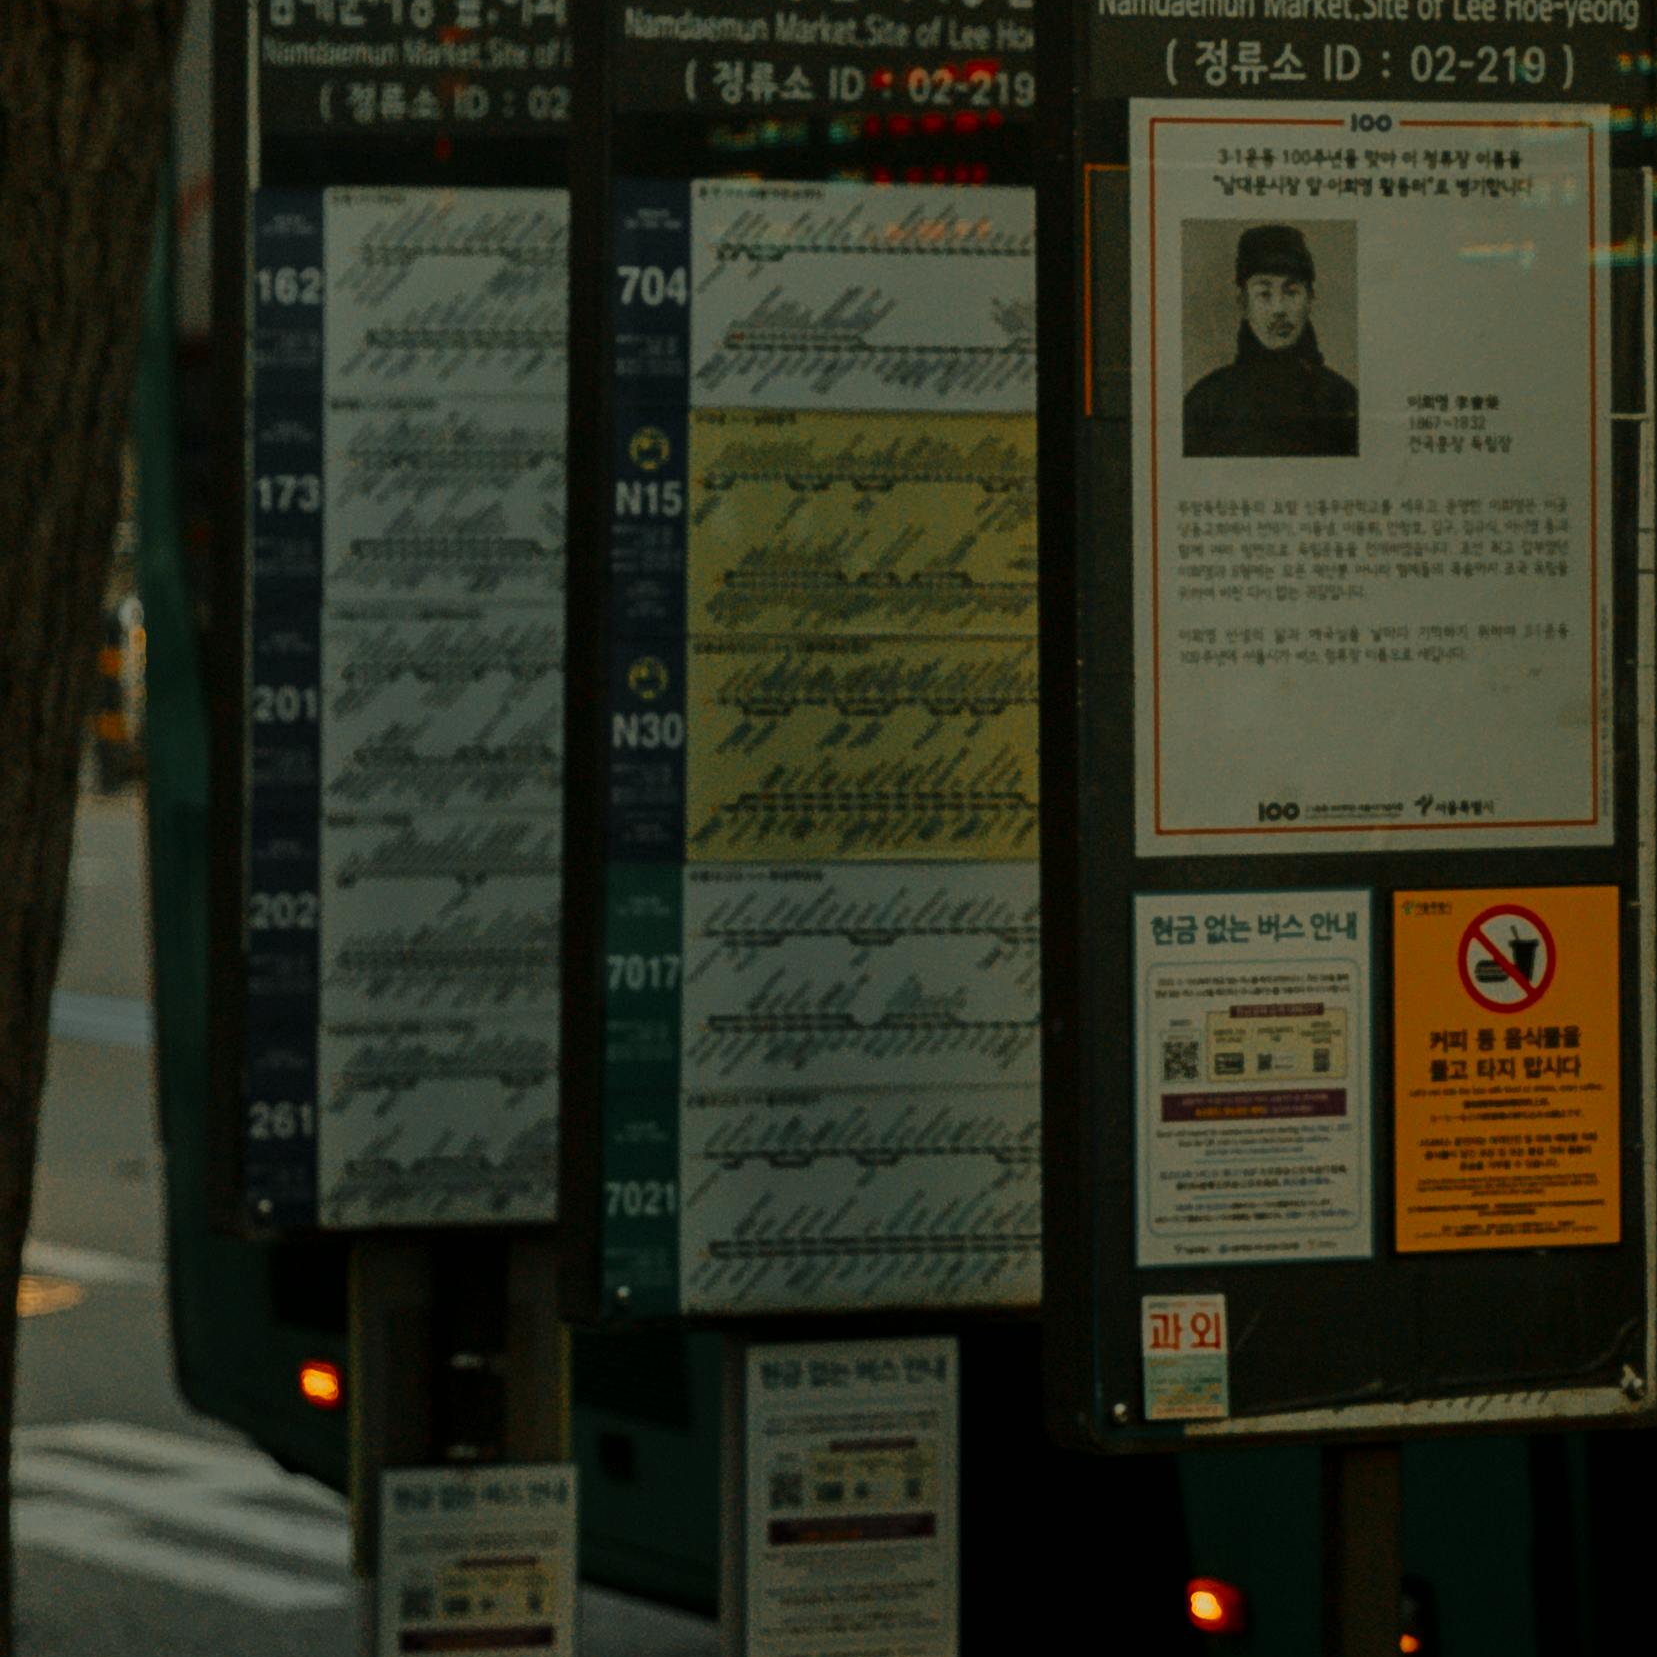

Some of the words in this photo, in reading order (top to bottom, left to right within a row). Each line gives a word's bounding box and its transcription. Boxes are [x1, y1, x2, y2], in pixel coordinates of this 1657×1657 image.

[948, 19, 991, 51] Lee
[712, 59, 816, 105] 정류소
[828, 66, 864, 101] ID
[907, 66, 1036, 107] 02-219
[1195, 40, 1307, 88] 정류소
[1325, 44, 1361, 82] ID
[1411, 44, 1546, 84] 02-219
[256, 266, 322, 306] 162
[617, 266, 688, 306] 704
[256, 474, 321, 514] 173
[615, 480, 684, 517] N15
[253, 684, 318, 725] 201
[611, 711, 684, 751] N30
[1258, 802, 1300, 821] 100
[249, 890, 317, 930] 202
[1150, 914, 1199, 947] 현금
[1203, 914, 1253, 946] 없는
[1256, 913, 1306, 943] 버스
[1309, 910, 1358, 942] 안내
[607, 954, 681, 991] 7017
[1429, 1029, 1468, 1053] 커피
[1503, 1024, 1582, 1051] 음식물을
[1476, 1054, 1516, 1081] 타지
[1522, 1054, 1582, 1080] 맙시다
[247, 1099, 315, 1140] 261
[605, 1180, 677, 1217] 7021
